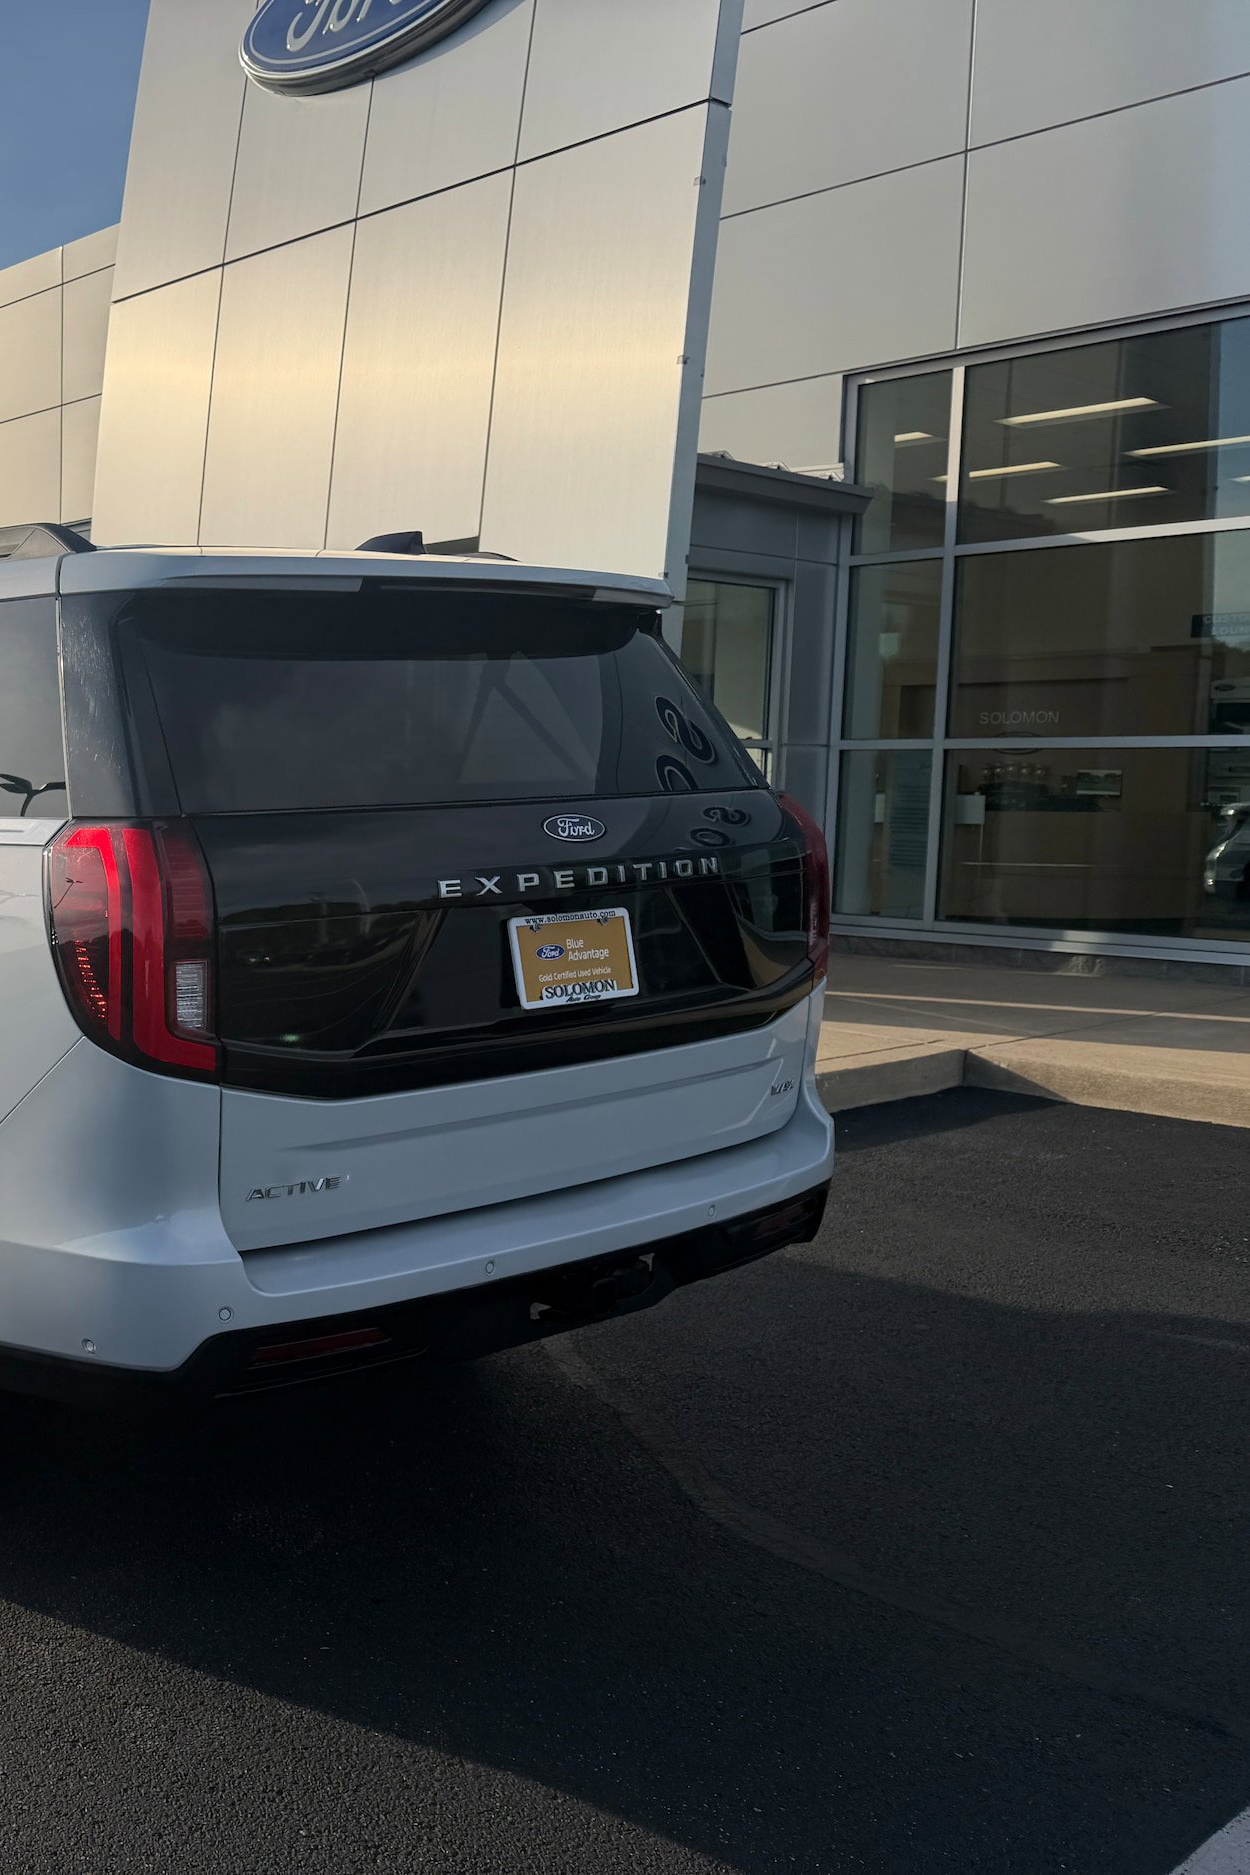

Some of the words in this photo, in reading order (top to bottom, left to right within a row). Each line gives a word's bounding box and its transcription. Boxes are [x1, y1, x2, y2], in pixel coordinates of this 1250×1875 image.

[978, 710, 1060, 725] SOLOMON
[557, 817, 596, 837] Ford
[437, 856, 719, 899] EXPEDITION
[524, 909, 616, 924] www.solomonauto.com
[566, 938, 584, 949] Blue
[541, 946, 560, 958] Ford
[568, 947, 610, 961] Advantage
[538, 973, 552, 983] Gold
[553, 970, 577, 980] Certified
[578, 967, 591, 977] Used
[544, 979, 616, 999] SOLOMON
[244, 1176, 343, 1201] ACTIVE
